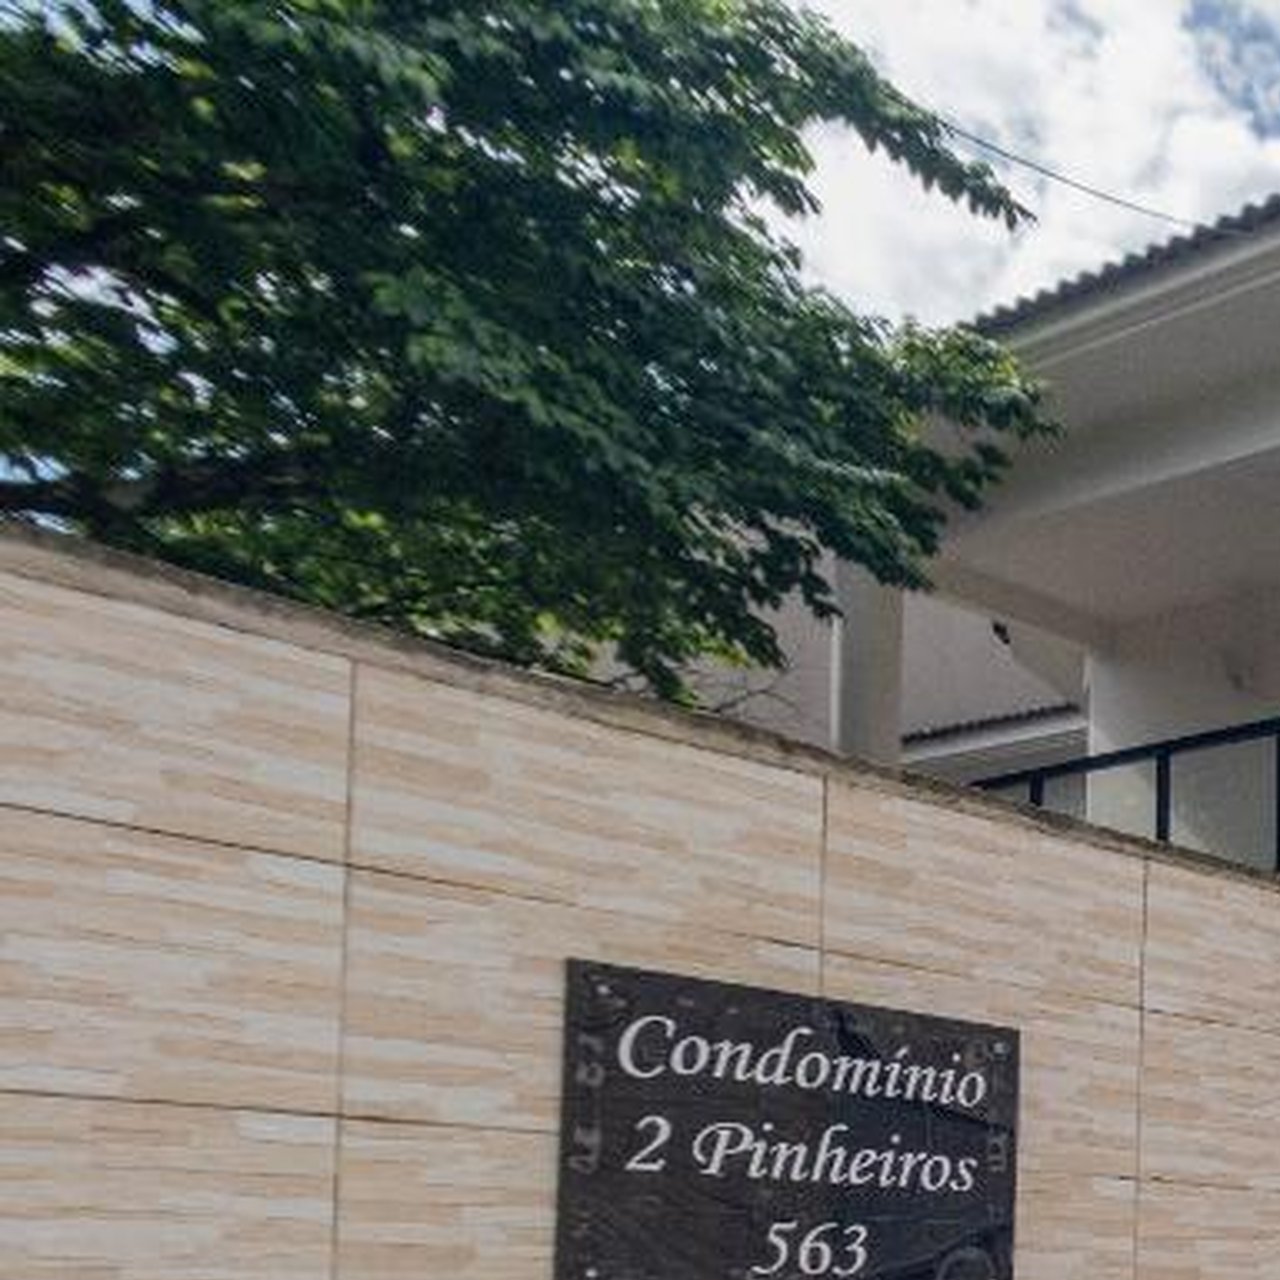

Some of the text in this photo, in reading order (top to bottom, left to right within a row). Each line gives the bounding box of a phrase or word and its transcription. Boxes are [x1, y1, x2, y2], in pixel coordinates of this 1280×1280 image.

[617, 1014, 987, 1108] Condomínio
[624, 1115, 978, 1192] 2 Pinheiros
[752, 1221, 868, 1277] 563
